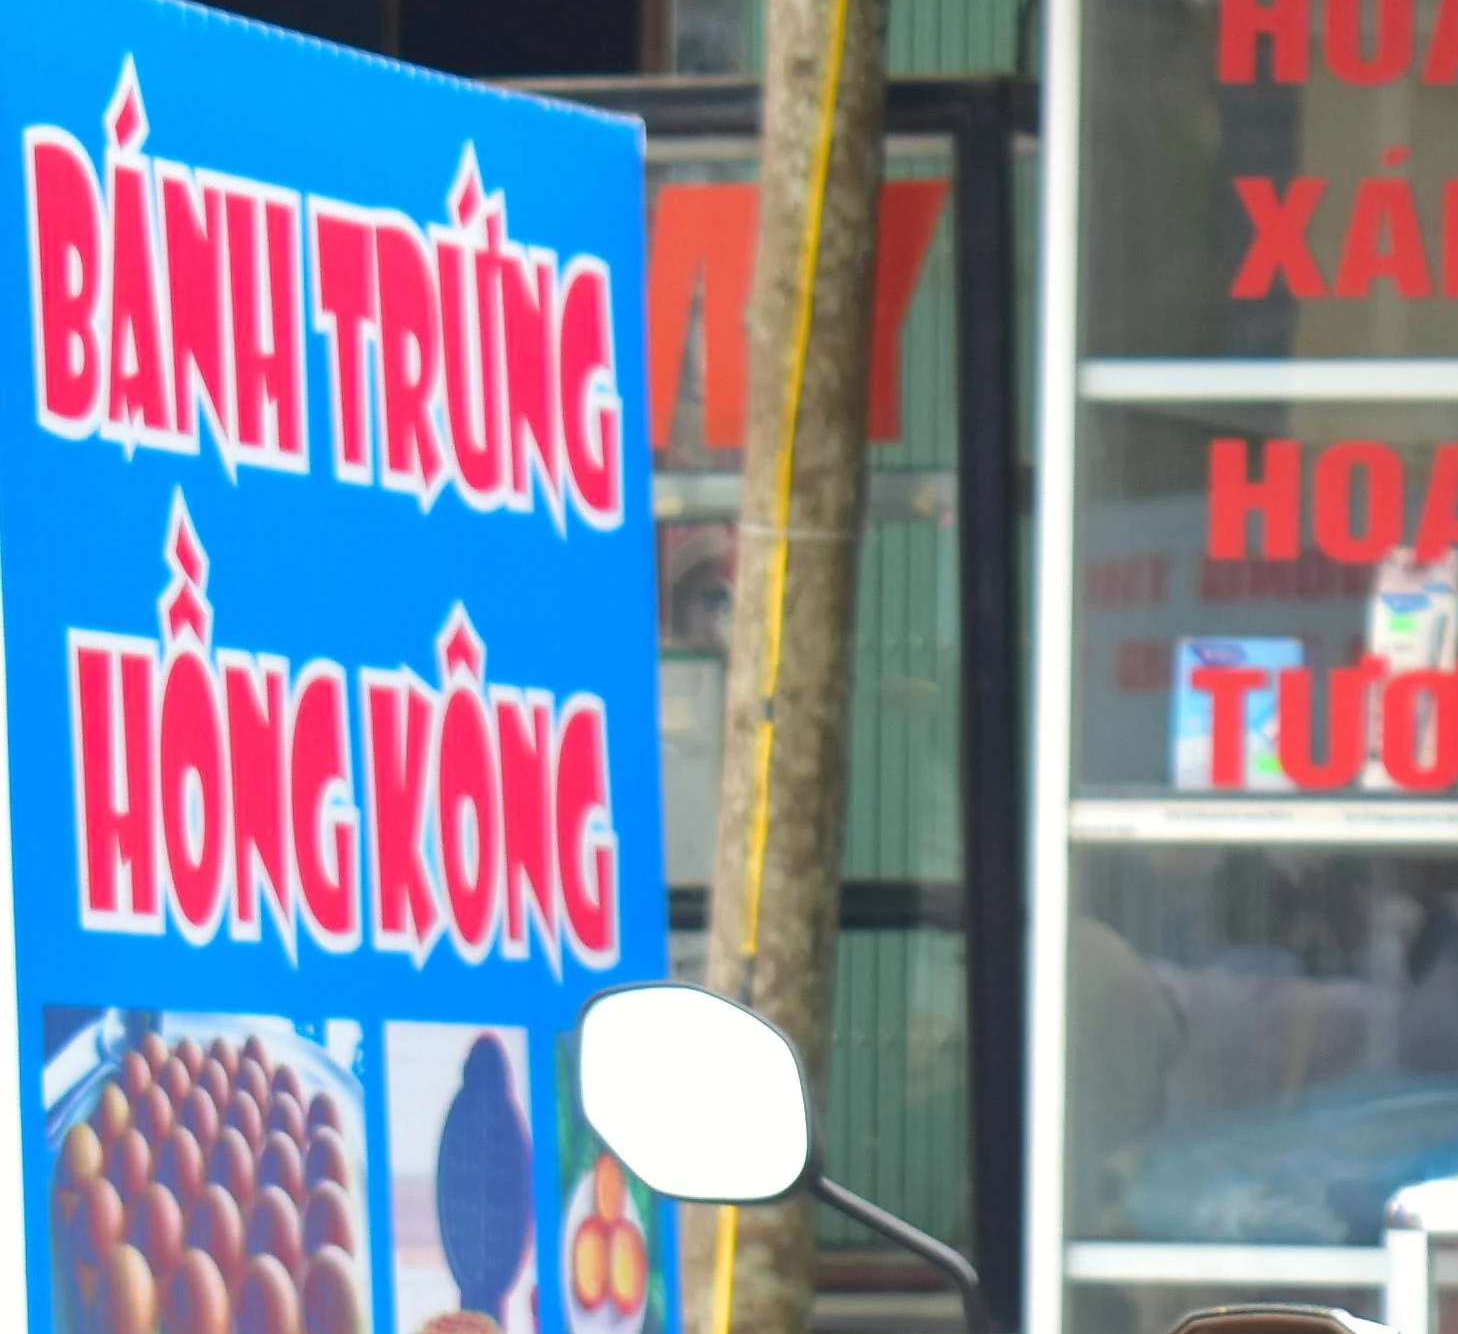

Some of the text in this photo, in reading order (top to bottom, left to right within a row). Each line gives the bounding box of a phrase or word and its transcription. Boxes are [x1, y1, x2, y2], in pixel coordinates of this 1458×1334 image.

[24, 53, 624, 536] BÁNH TRỨNG
[67, 485, 620, 981] HỒNG KÔNG
